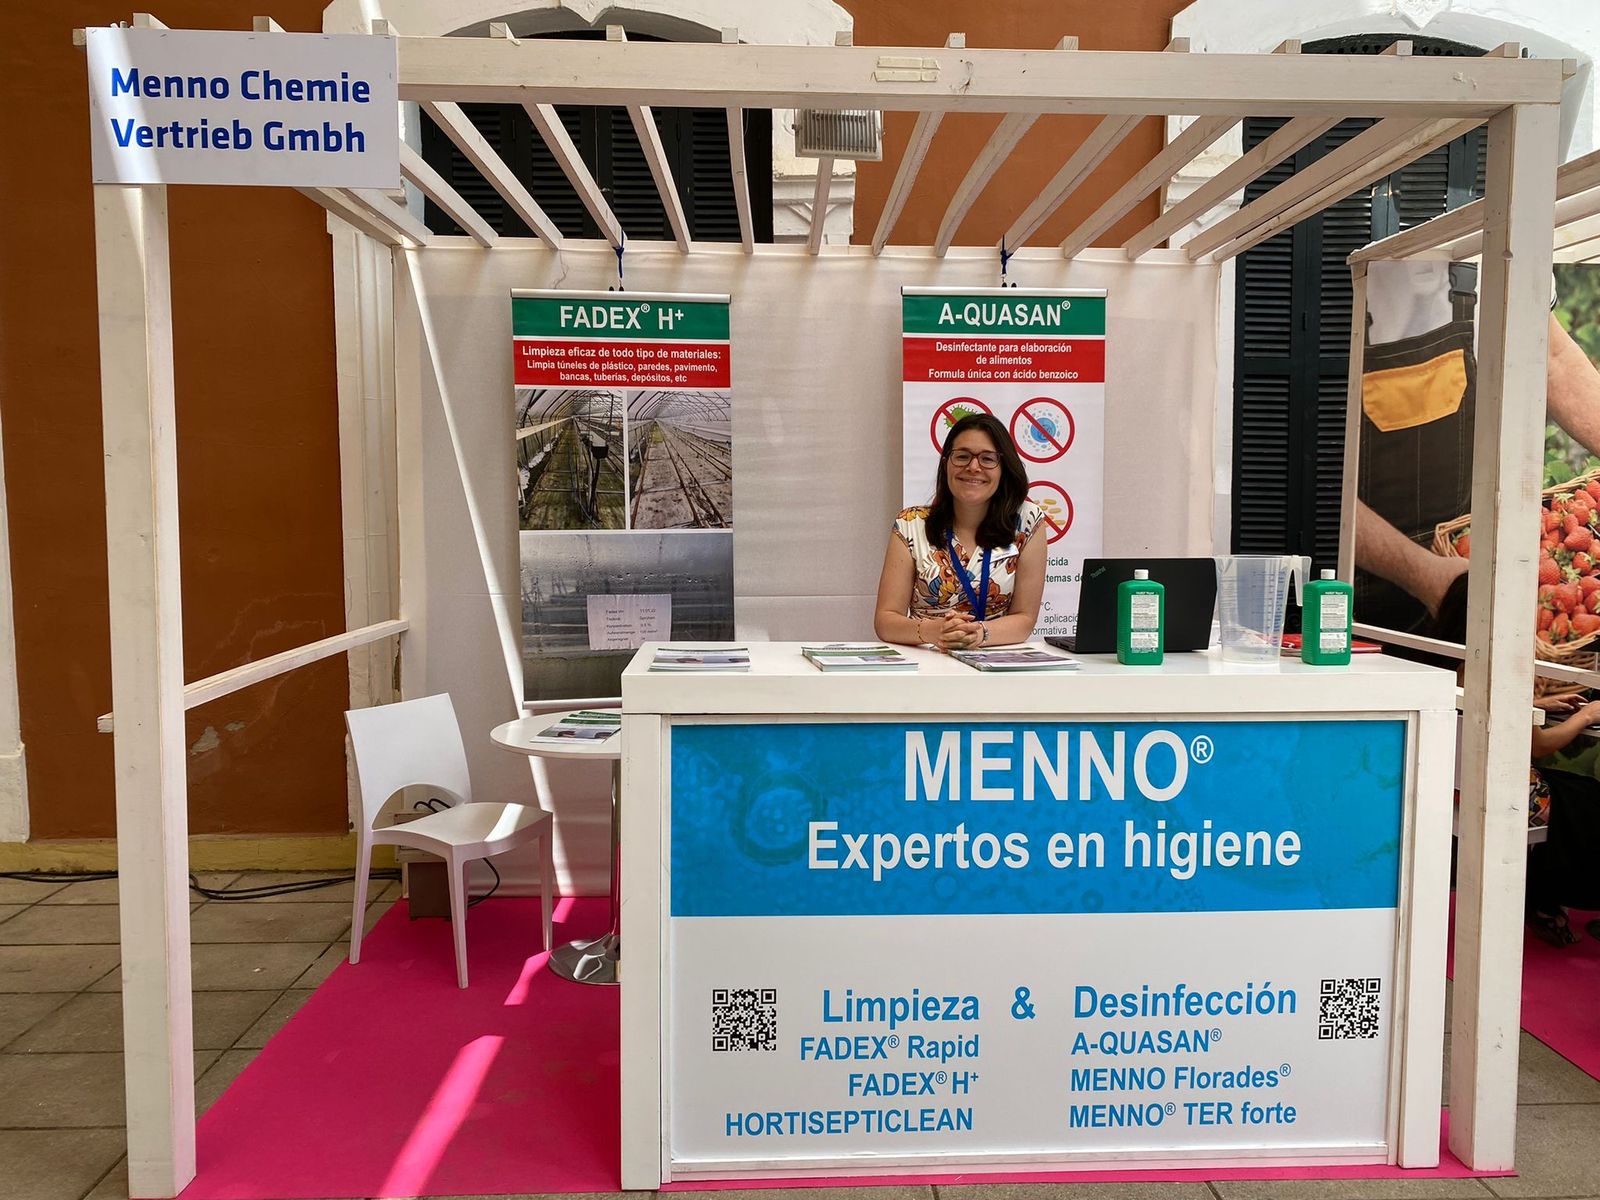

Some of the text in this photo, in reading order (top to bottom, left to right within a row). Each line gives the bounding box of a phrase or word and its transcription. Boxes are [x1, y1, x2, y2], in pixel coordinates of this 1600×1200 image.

[111, 68, 370, 103] Menno Chemie
[111, 118, 365, 153] Vertrieb Gmbh
[560, 303, 684, 330] FADEX® H+
[938, 300, 1070, 326] A-QUASAN®
[522, 346, 721, 360] Limpieza eficaz de todo tipo de materiales:
[936, 342, 1072, 354] Desinfectante para elaboración
[976, 355, 1032, 365] de alimentos
[527, 360, 718, 373] Limpia túneles de plástico, paredes, pavimento,
[560, 372, 688, 384] bancas, tuberías, depósitos, etc
[928, 369, 1078, 380] Formula única con ácido benzoico
[905, 730, 1214, 801] MENNO®
[808, 820, 1301, 882] Expertos en higiene
[823, 982, 1297, 1030] Limpieza & Desinfección
[800, 1034, 980, 1063] FADEX® Rapid
[1071, 1027, 1222, 1056] A-QUASAN®
[849, 1070, 979, 1096] FADEX® H+
[1071, 1063, 1292, 1091] MENNO Florades®
[725, 1108, 973, 1136] HORTISEPTICLEAN
[1069, 1101, 1298, 1128] MENNO® TER forte
